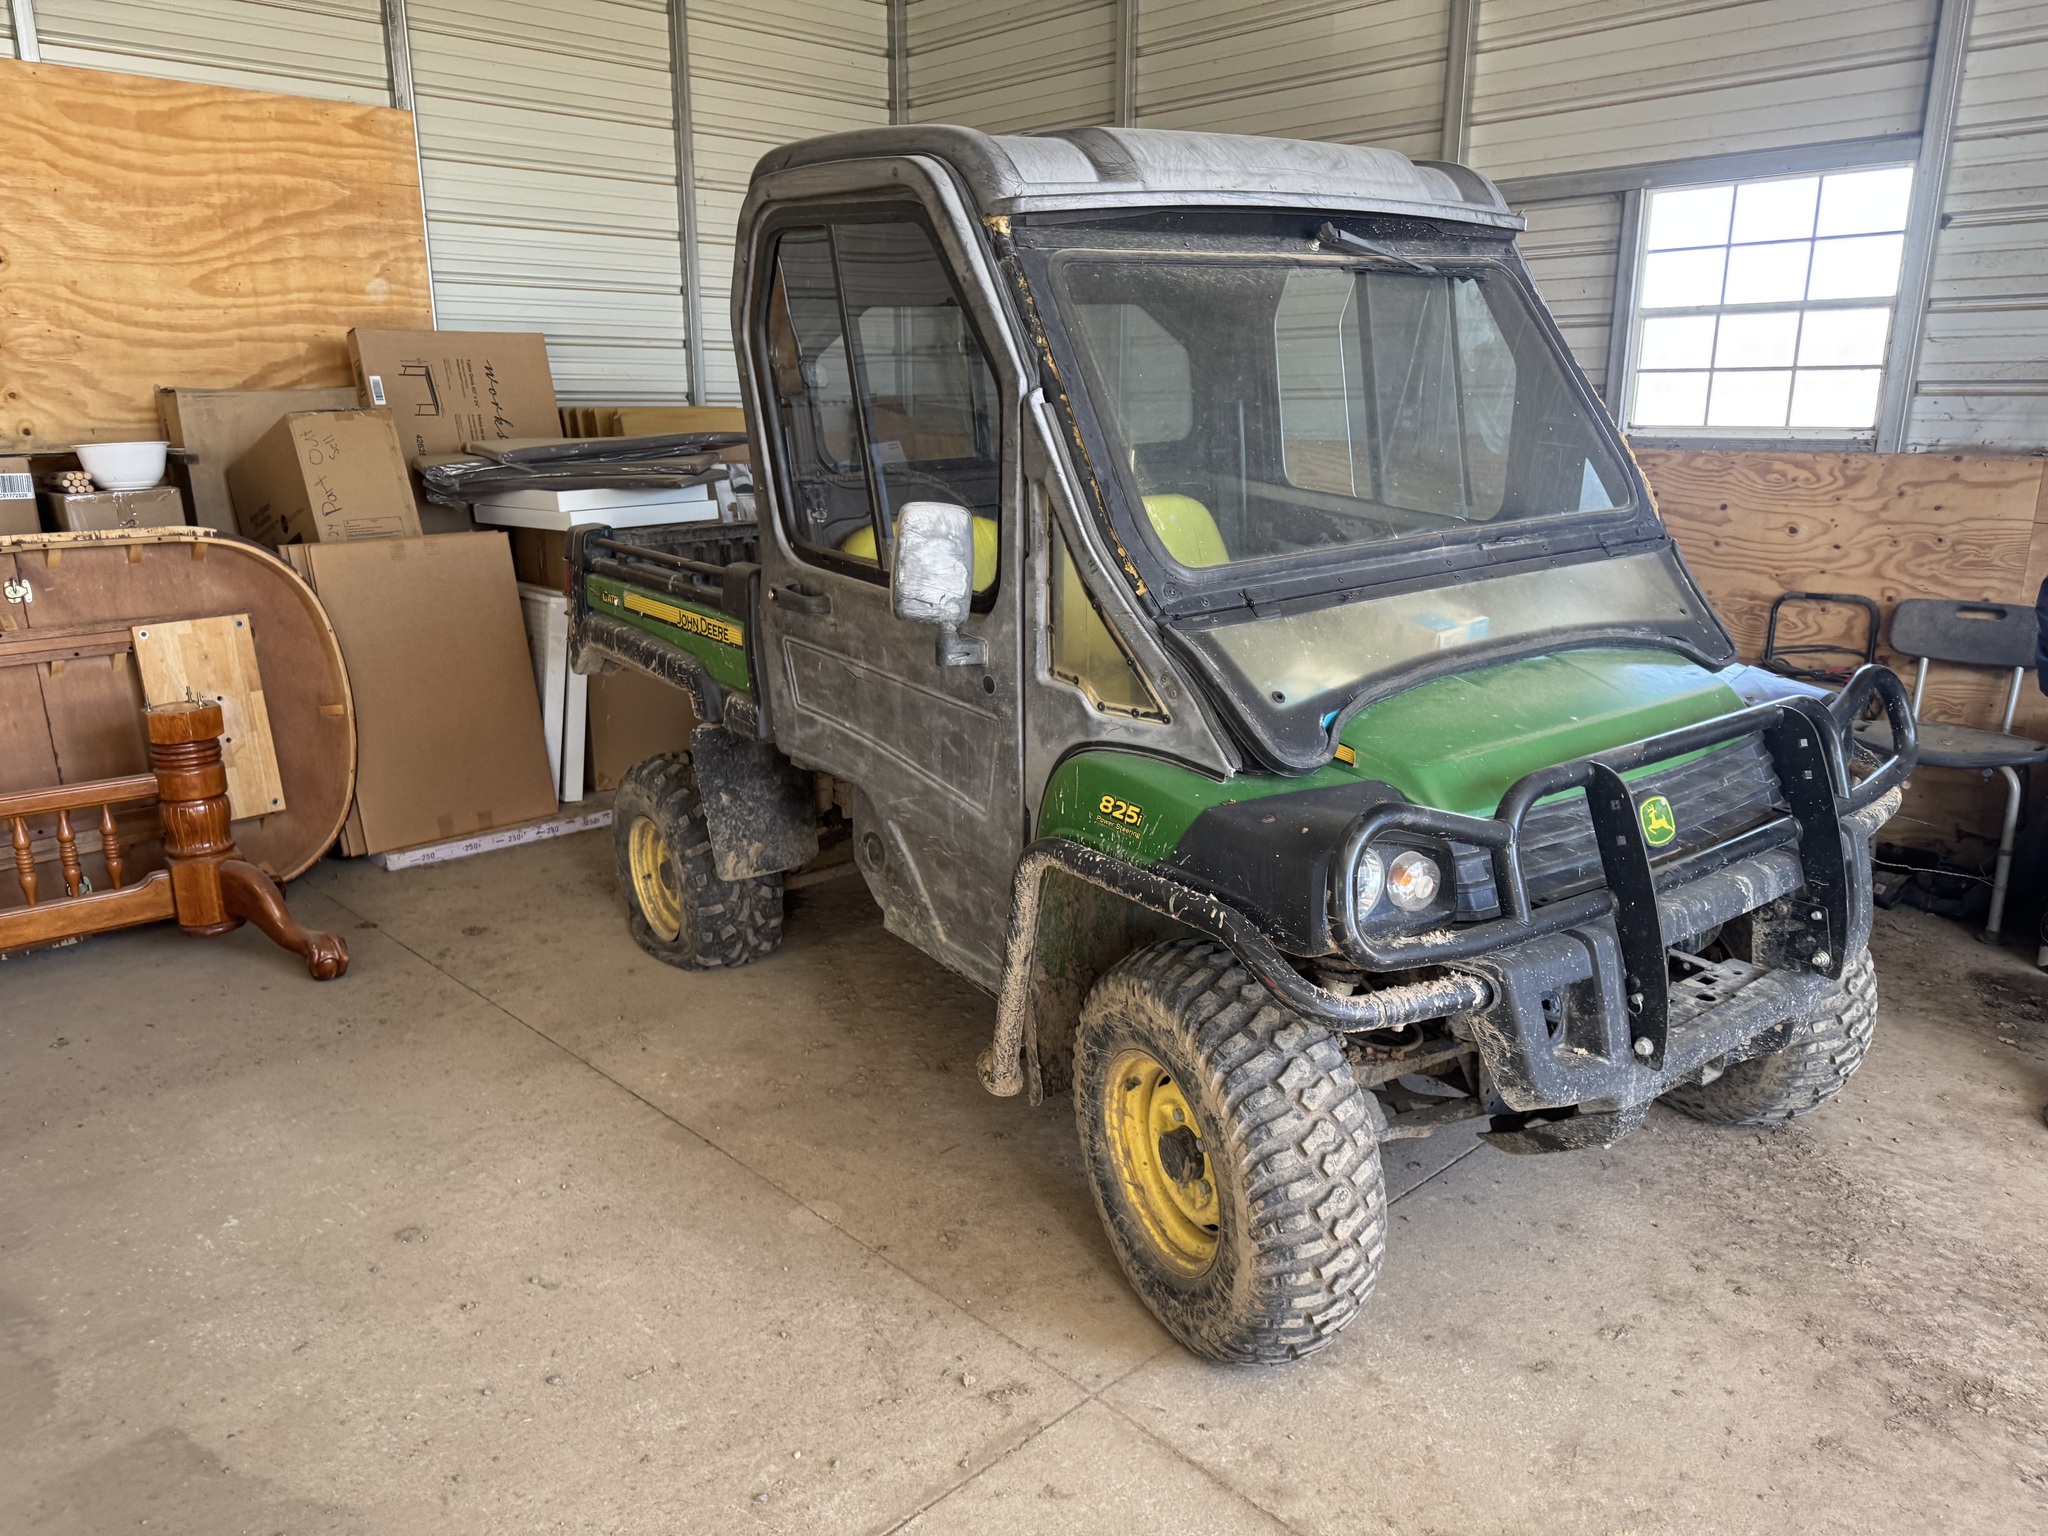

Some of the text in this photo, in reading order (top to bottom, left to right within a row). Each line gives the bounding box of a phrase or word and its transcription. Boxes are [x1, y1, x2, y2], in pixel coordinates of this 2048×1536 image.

[300, 430, 324, 465] Out
[314, 474, 343, 517] Part
[677, 611, 730, 642] JOHN DEERE
[1099, 795, 1143, 827] 825i
[1096, 815, 1141, 840] Power Steering
